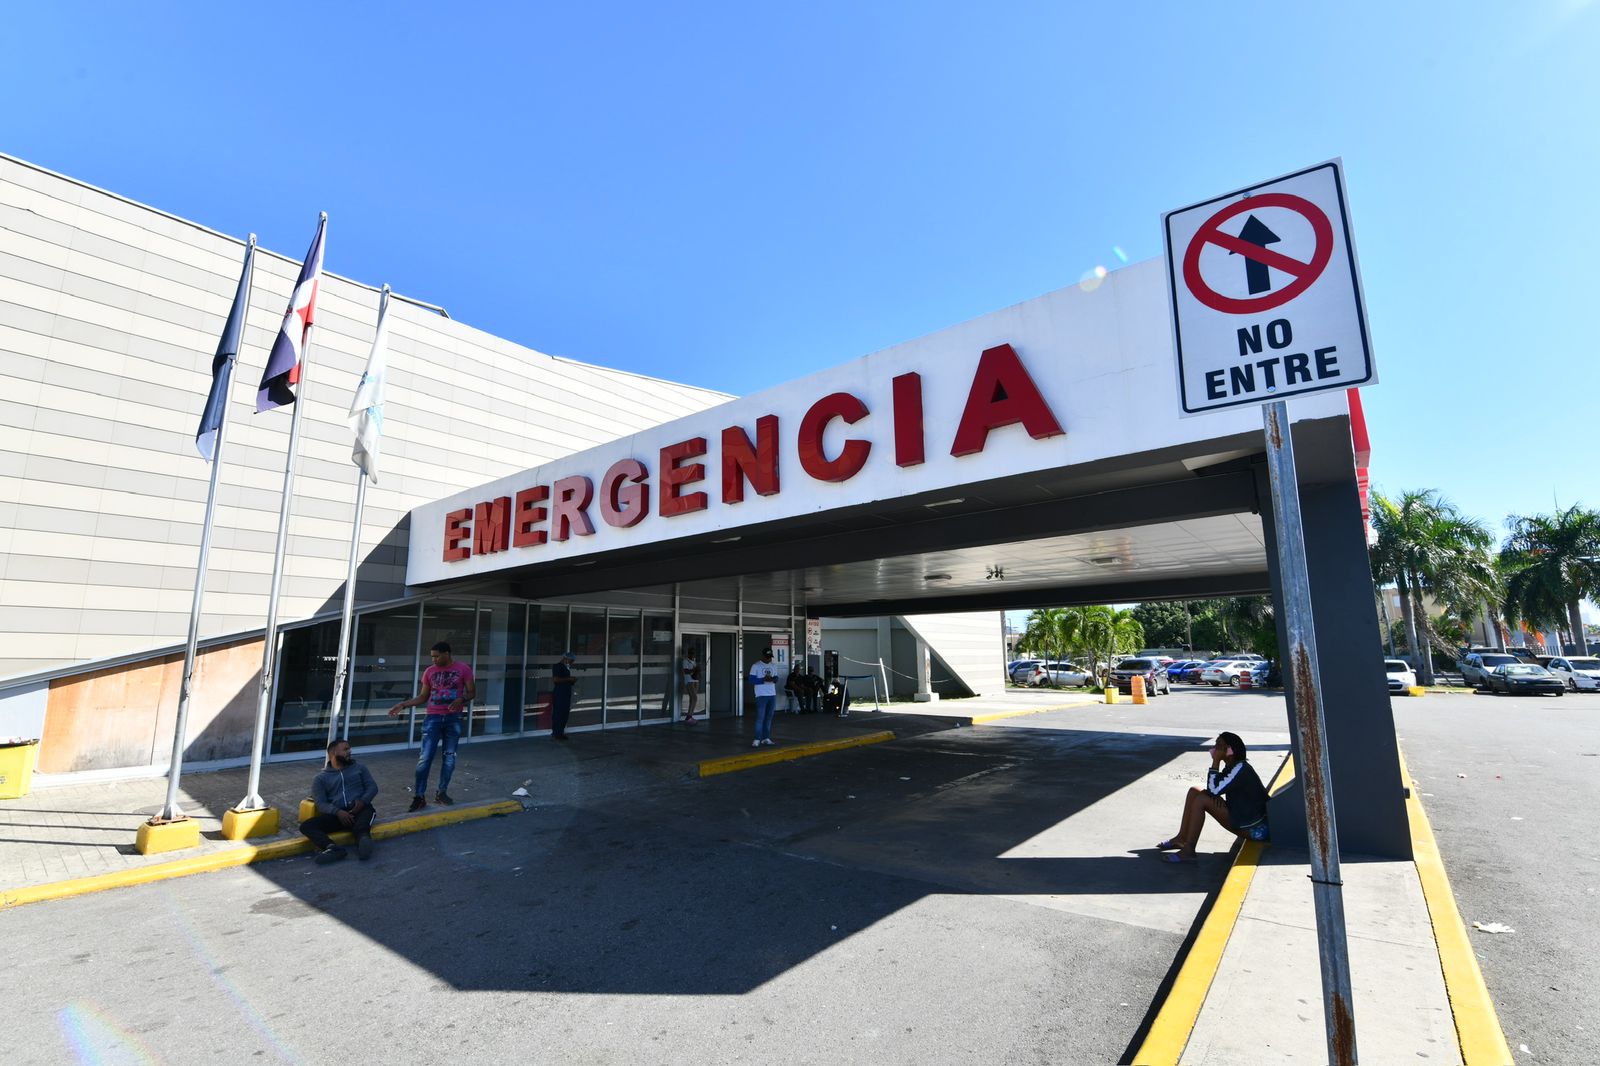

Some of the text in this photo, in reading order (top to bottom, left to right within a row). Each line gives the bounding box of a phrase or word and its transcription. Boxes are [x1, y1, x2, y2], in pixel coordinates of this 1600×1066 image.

[1236, 318, 1293, 357] NO
[1204, 345, 1341, 401] ENTRE
[442, 342, 1066, 563] EMERGENCIA
